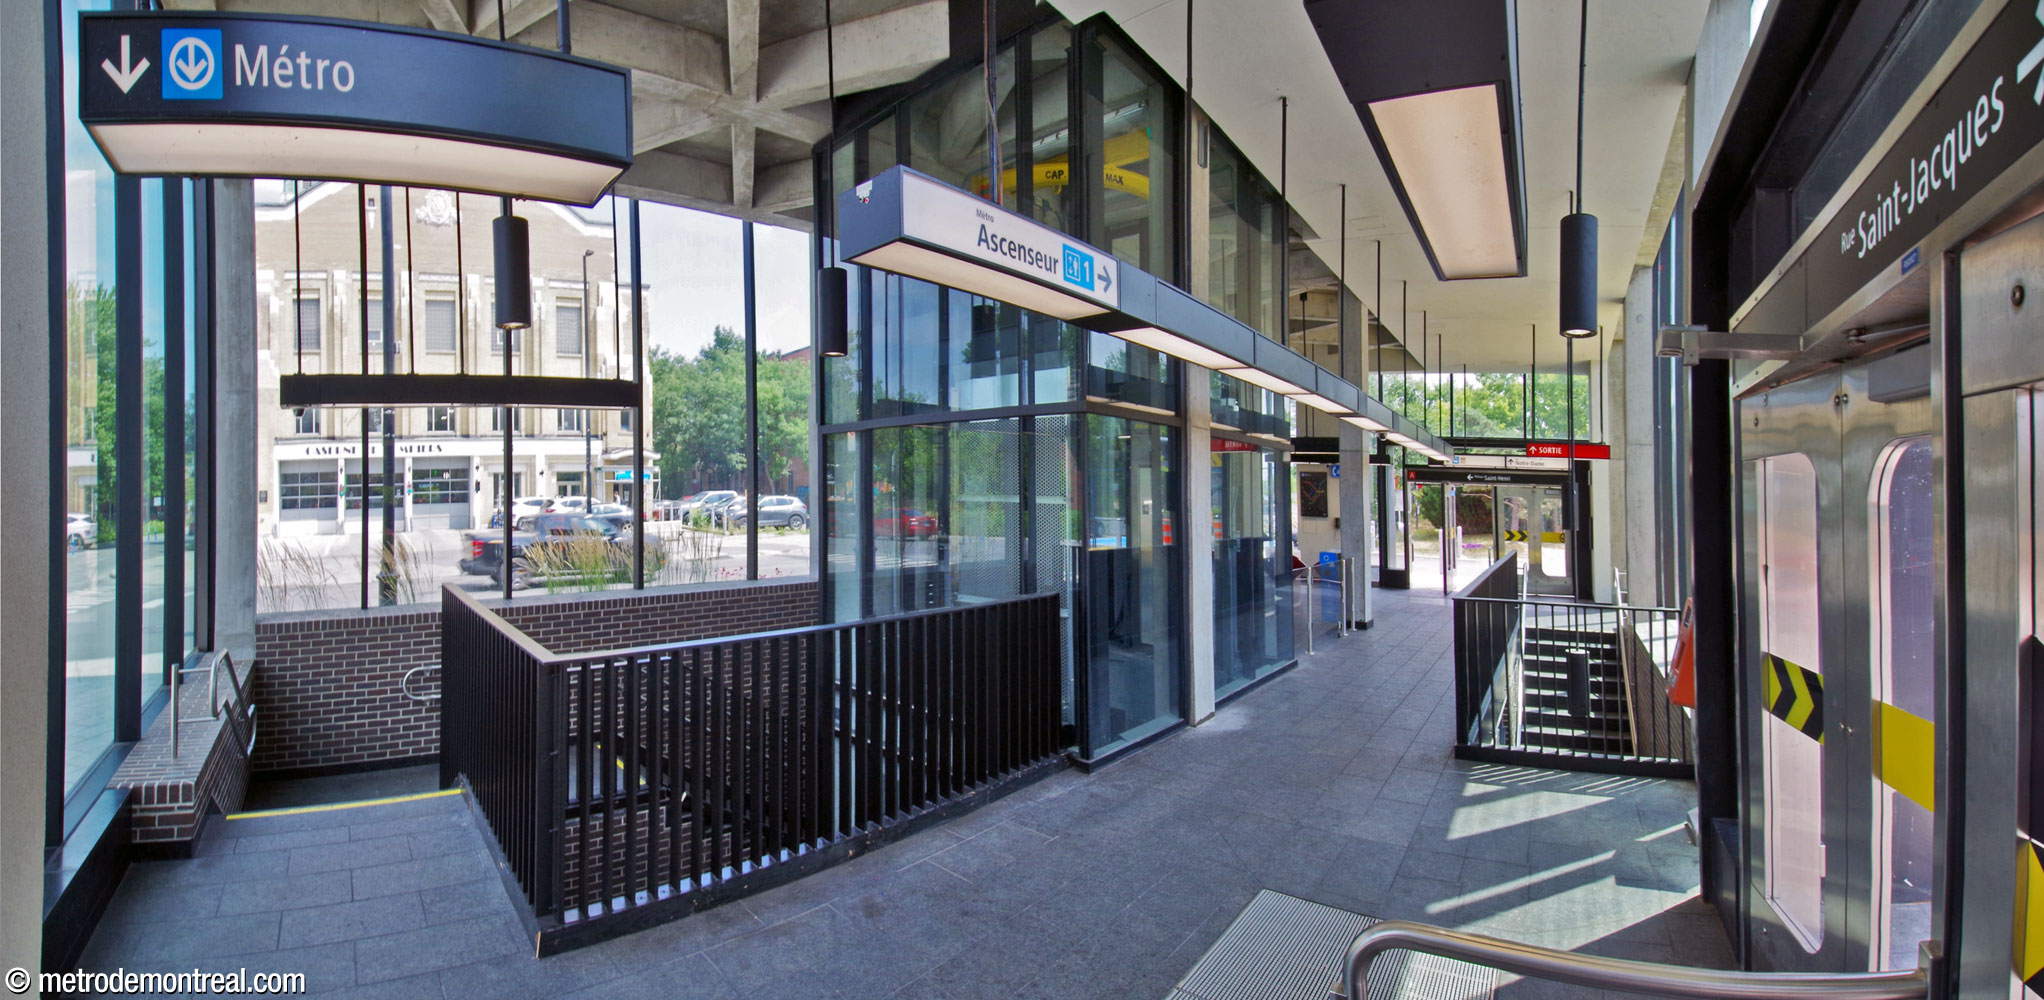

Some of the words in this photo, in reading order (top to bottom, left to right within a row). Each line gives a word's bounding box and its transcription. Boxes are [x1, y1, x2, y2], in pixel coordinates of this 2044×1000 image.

[234, 43, 355, 93] Métro
[1841, 227, 1856, 254] Rue
[1857, 75, 2005, 259] Saint-Jacques
[1105, 172, 1124, 186] MAX
[976, 208, 995, 223] Métro
[977, 223, 1059, 275] Ascenseur
[1083, 259, 1091, 284] 1
[1538, 446, 1562, 455] SORTIE
[1409, 471, 1416, 480] A
[1484, 474, 1511, 482] Saint-Henri
